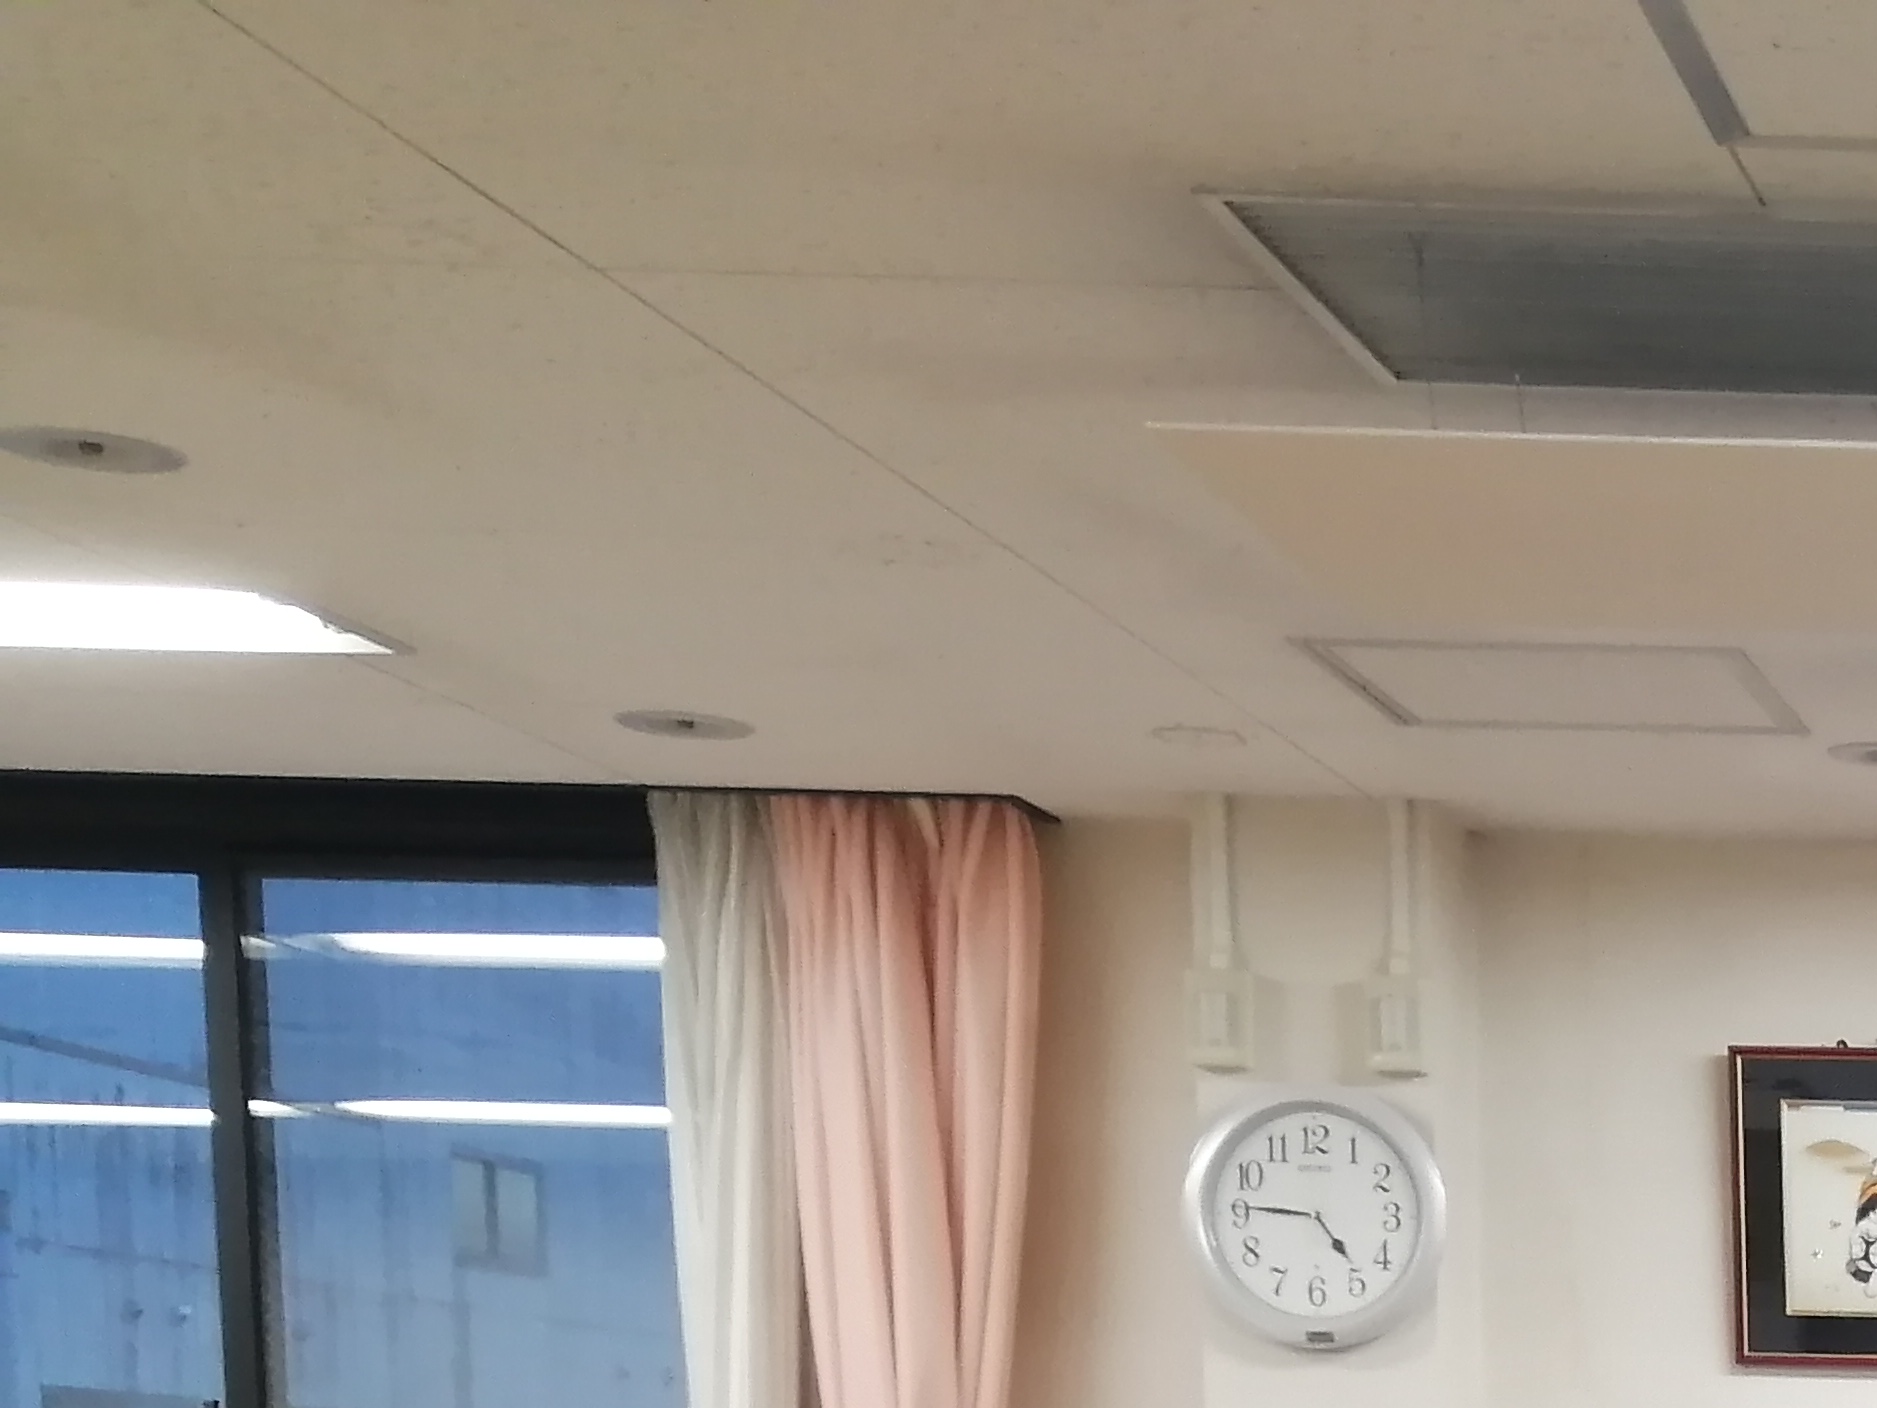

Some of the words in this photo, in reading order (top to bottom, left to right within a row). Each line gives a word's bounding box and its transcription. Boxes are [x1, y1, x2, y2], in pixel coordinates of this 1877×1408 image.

[1266, 1135, 1289, 1163] 11
[1301, 1125, 1331, 1155] 12
[1348, 1137, 1358, 1164] 1
[1238, 1160, 1263, 1191] 10
[1372, 1164, 1390, 1193] 2
[1230, 1199, 1250, 1229] 9
[1383, 1202, 1401, 1232] 3
[1243, 1237, 1261, 1267] 8
[1374, 1240, 1392, 1271] 4
[1271, 1268, 1288, 1297] 7
[1309, 1277, 1327, 1308] 6
[1348, 1269, 1366, 1297] 5
